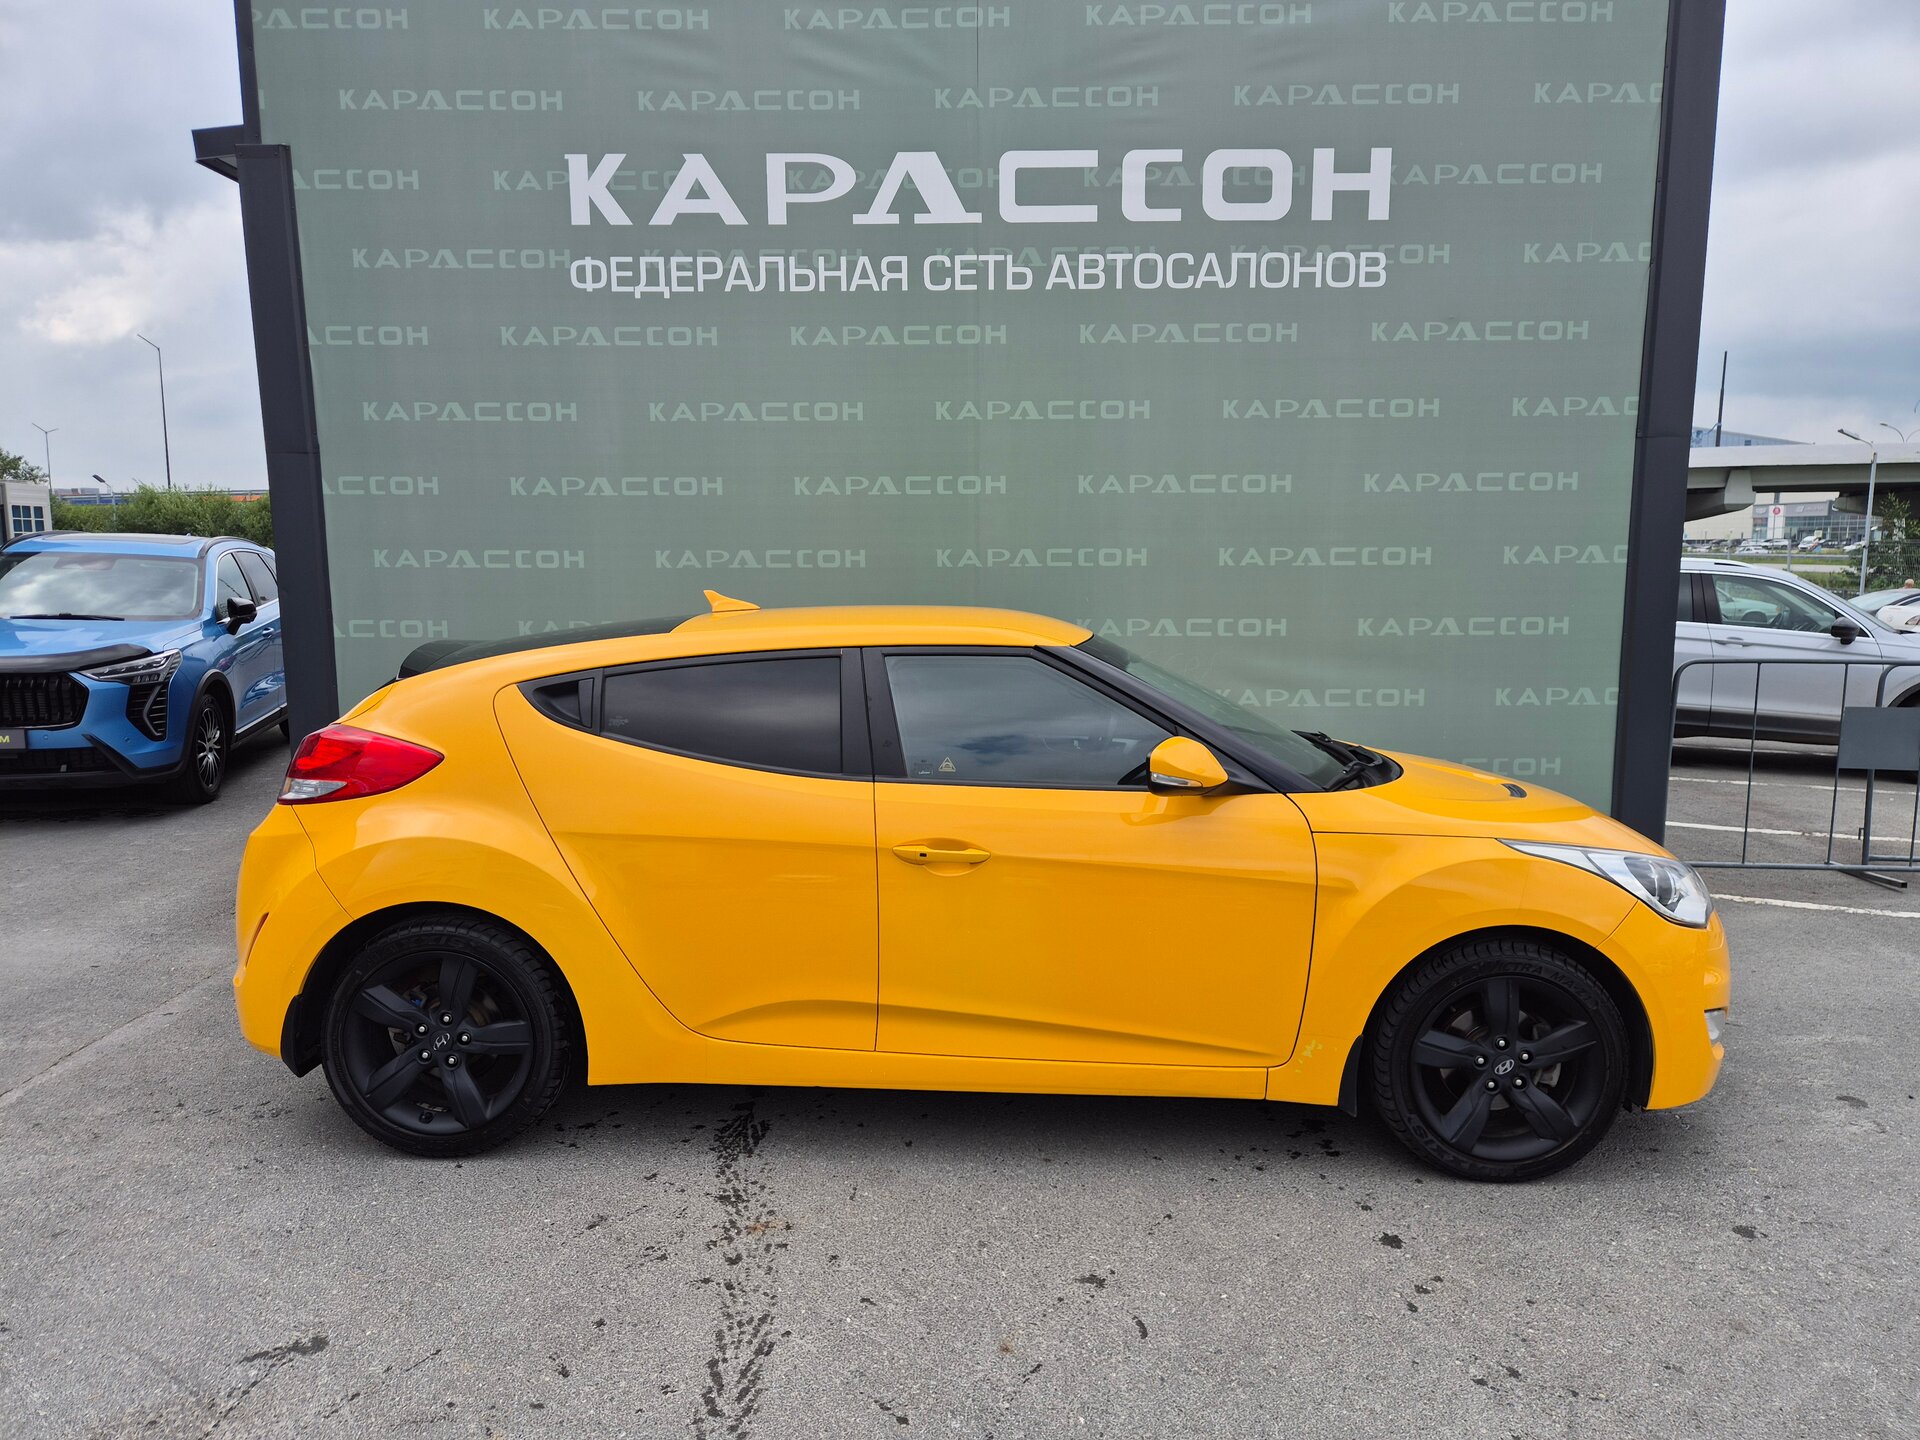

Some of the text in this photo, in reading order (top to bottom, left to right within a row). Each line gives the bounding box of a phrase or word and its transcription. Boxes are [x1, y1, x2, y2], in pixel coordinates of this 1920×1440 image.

[570, 252, 1388, 299] ФЕДЕРАЛЬНАЯ СЕТЬ АВТОСАЛОНОВ
